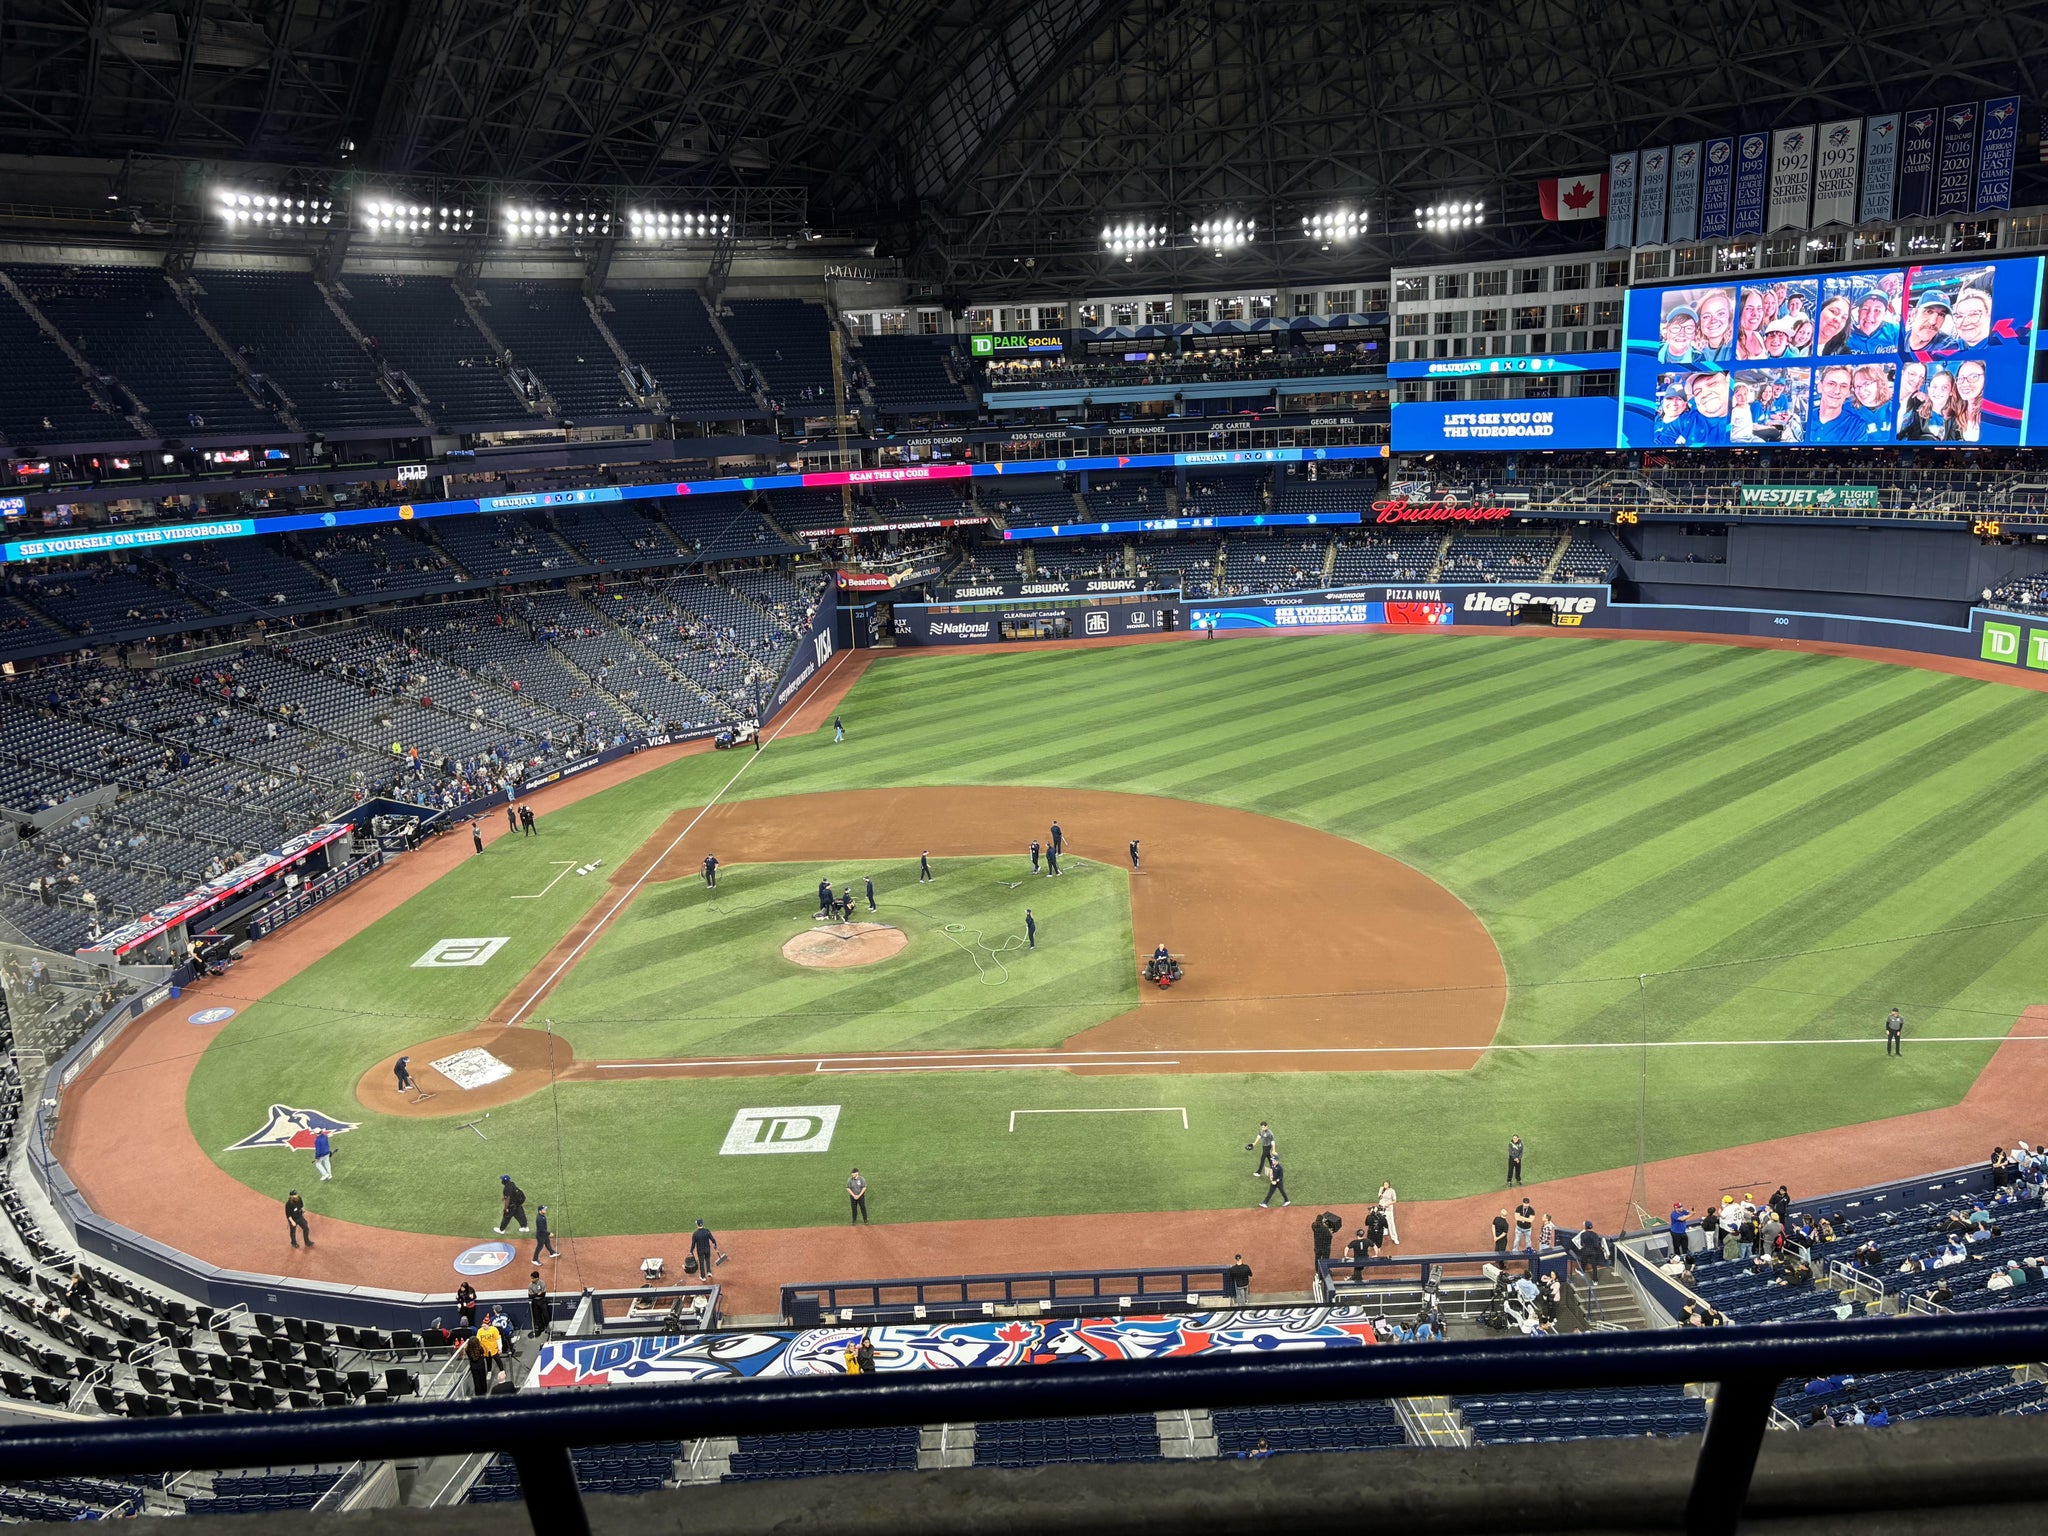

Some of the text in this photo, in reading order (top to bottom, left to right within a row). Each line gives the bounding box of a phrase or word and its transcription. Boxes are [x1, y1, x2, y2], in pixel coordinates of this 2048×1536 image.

[1986, 127, 2013, 141] 2025
[1870, 143, 1893, 156] 2015
[1906, 139, 1931, 151] 2016
[1945, 141, 1970, 154] 2016
[1984, 142, 2012, 151] AMERICAN
[1822, 148, 1855, 166] 1993
[1905, 152, 1931, 165] ALDS
[1983, 149, 2012, 160] LEAGUE
[1742, 160, 1763, 172] 1993
[1777, 154, 1808, 172] 1992
[1942, 158, 1970, 171] 2020
[1982, 158, 2011, 170] EAST
[1708, 165, 1728, 177] 1992
[1820, 167, 1854, 180] WORLD
[1868, 164, 1892, 174] LEAGUE
[1904, 164, 1930, 174] CHAMPS
[1981, 169, 2010, 178] CHAMPS
[1644, 174, 1663, 185] 1989
[1676, 170, 1694, 181] 1991
[1775, 172, 1808, 186] WORLD
[1867, 172, 1892, 184] EAST
[1613, 178, 1632, 190] 1985
[1707, 178, 1728, 186] AMERICAN
[1739, 180, 1762, 189] LEAGUE
[1818, 178, 1853, 192] SERIES
[1866, 182, 1891, 191] CHAMPS
[1941, 175, 1968, 188] 2022
[1674, 190, 1694, 198] LEAGUE
[1706, 185, 1728, 193] LEAGUE
[1738, 187, 1762, 198] EAST
[1773, 183, 1807, 198] SERIES
[1980, 182, 2008, 195] ALCS
[1642, 194, 1663, 203] LEAGUE
[1705, 192, 1727, 203] EAST
[1772, 195, 1807, 205] CHAMPIONS
[1817, 189, 1853, 200] CHAMPIONS
[1940, 191, 1967, 205] 2023
[1979, 194, 2008, 203] CHAMPS
[1642, 201, 1662, 211] EAST
[1674, 196, 1694, 206] EAST
[1704, 202, 1726, 211] CHAMPS
[1737, 197, 1760, 206] CHAMPS
[1866, 195, 1890, 207] ALDS
[1611, 204, 1631, 214] EAST
[1641, 209, 1662, 218] CHAMPS
[1673, 206, 1694, 214] CHAMPS
[1864, 206, 1889, 216] CHAMPS
[1610, 212, 1630, 221] CHAMPS
[1704, 213, 1726, 225] ALCS
[1737, 209, 1760, 221] ALCS
[1703, 223, 1726, 233] CHAMPS
[1736, 219, 1759, 229] CHAMPS
[974, 339, 991, 352] TD
[994, 336, 1062, 346] PARK SOCIAL
[1444, 412, 1553, 425] LET'S SEE YOU ON
[1128, 426, 1165, 434] FERNANDEZ
[1443, 424, 1553, 438] THE VIDEOBOARD
[907, 438, 931, 446] CARLOS
[397, 471, 428, 480] KPMG
[849, 469, 928, 481] SCAN THE QR CODE
[1742, 488, 1817, 506] WESTJET
[1840, 490, 1876, 498] FLIGHT
[491, 497, 536, 508] @BLUEJAYS
[1372, 500, 1512, 524] Budweiser
[1616, 512, 1638, 524] 2:46
[898, 522, 926, 530] CANADA'S
[1973, 521, 2000, 535] 2:46
[20, 524, 242, 556] SEE YOURSELF ON THE VIDEOBOARD
[923, 567, 940, 576] COLOUR
[848, 578, 887, 586] BeautiTone
[1086, 580, 1136, 591] SUBWAY
[955, 586, 1003, 598] SUBWAY
[1020, 583, 1070, 594] SUBWAY
[1386, 589, 1441, 600] PIZZA NOVA
[1275, 604, 1367, 616] SEE YOURSELF ON
[1275, 613, 1367, 624] THE VIDEOBOARD
[1774, 617, 1789, 625] 400
[943, 622, 990, 633] National
[814, 627, 832, 667] VISA
[1988, 629, 2016, 655] TD
[647, 735, 670, 746] VISA
[564, 762, 588, 775] BASELINE
[746, 1116, 823, 1143] TD
